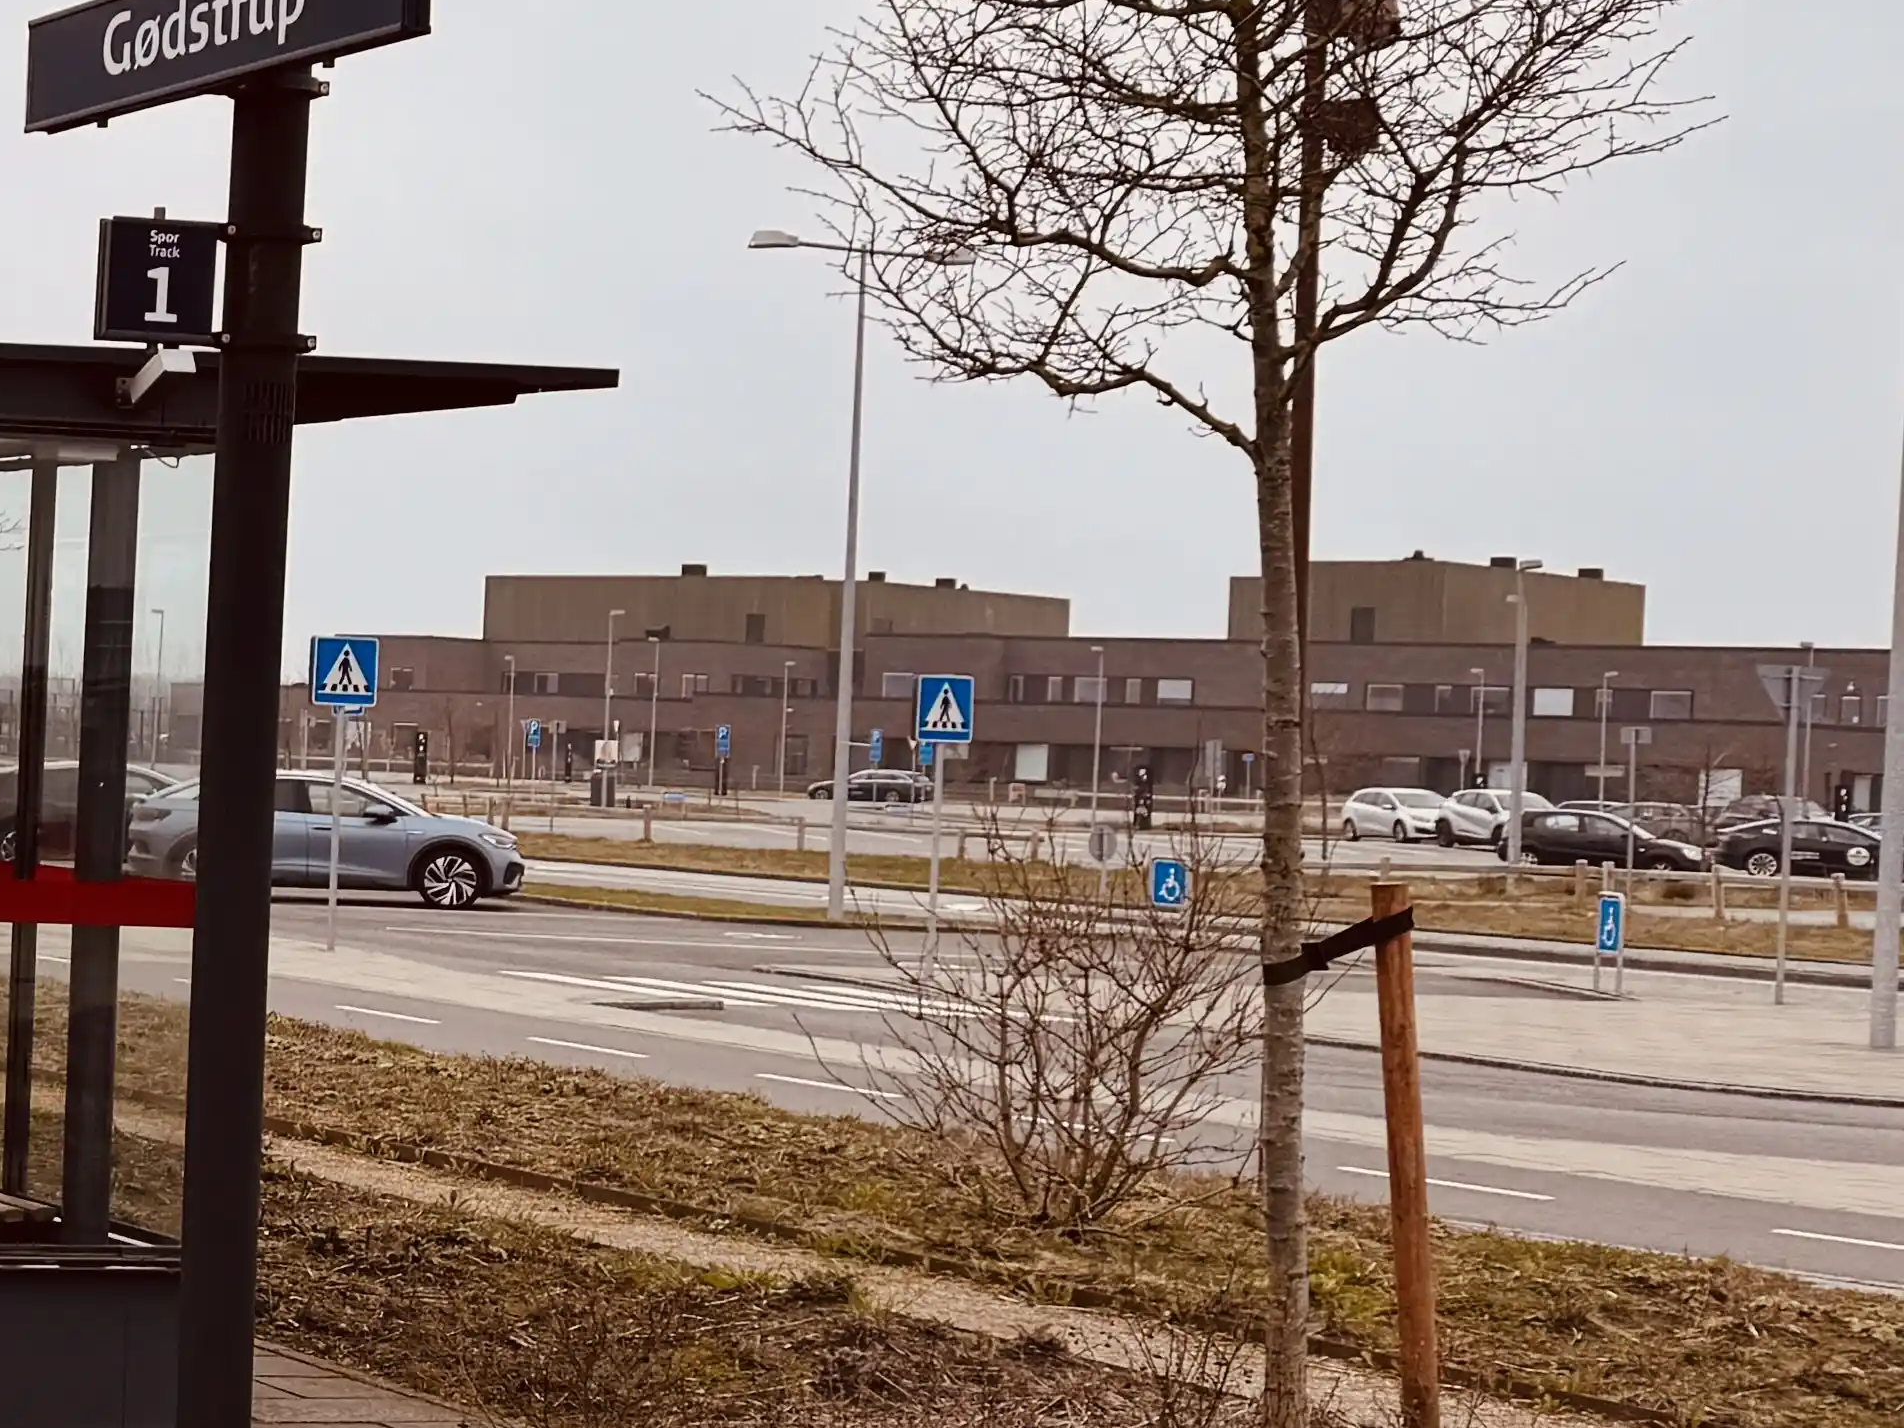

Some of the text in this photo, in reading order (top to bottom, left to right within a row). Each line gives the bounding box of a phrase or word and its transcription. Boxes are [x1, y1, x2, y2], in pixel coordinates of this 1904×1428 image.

[150, 229, 180, 244] Spor
[148, 244, 180, 258] Track
[144, 266, 178, 323] 1
